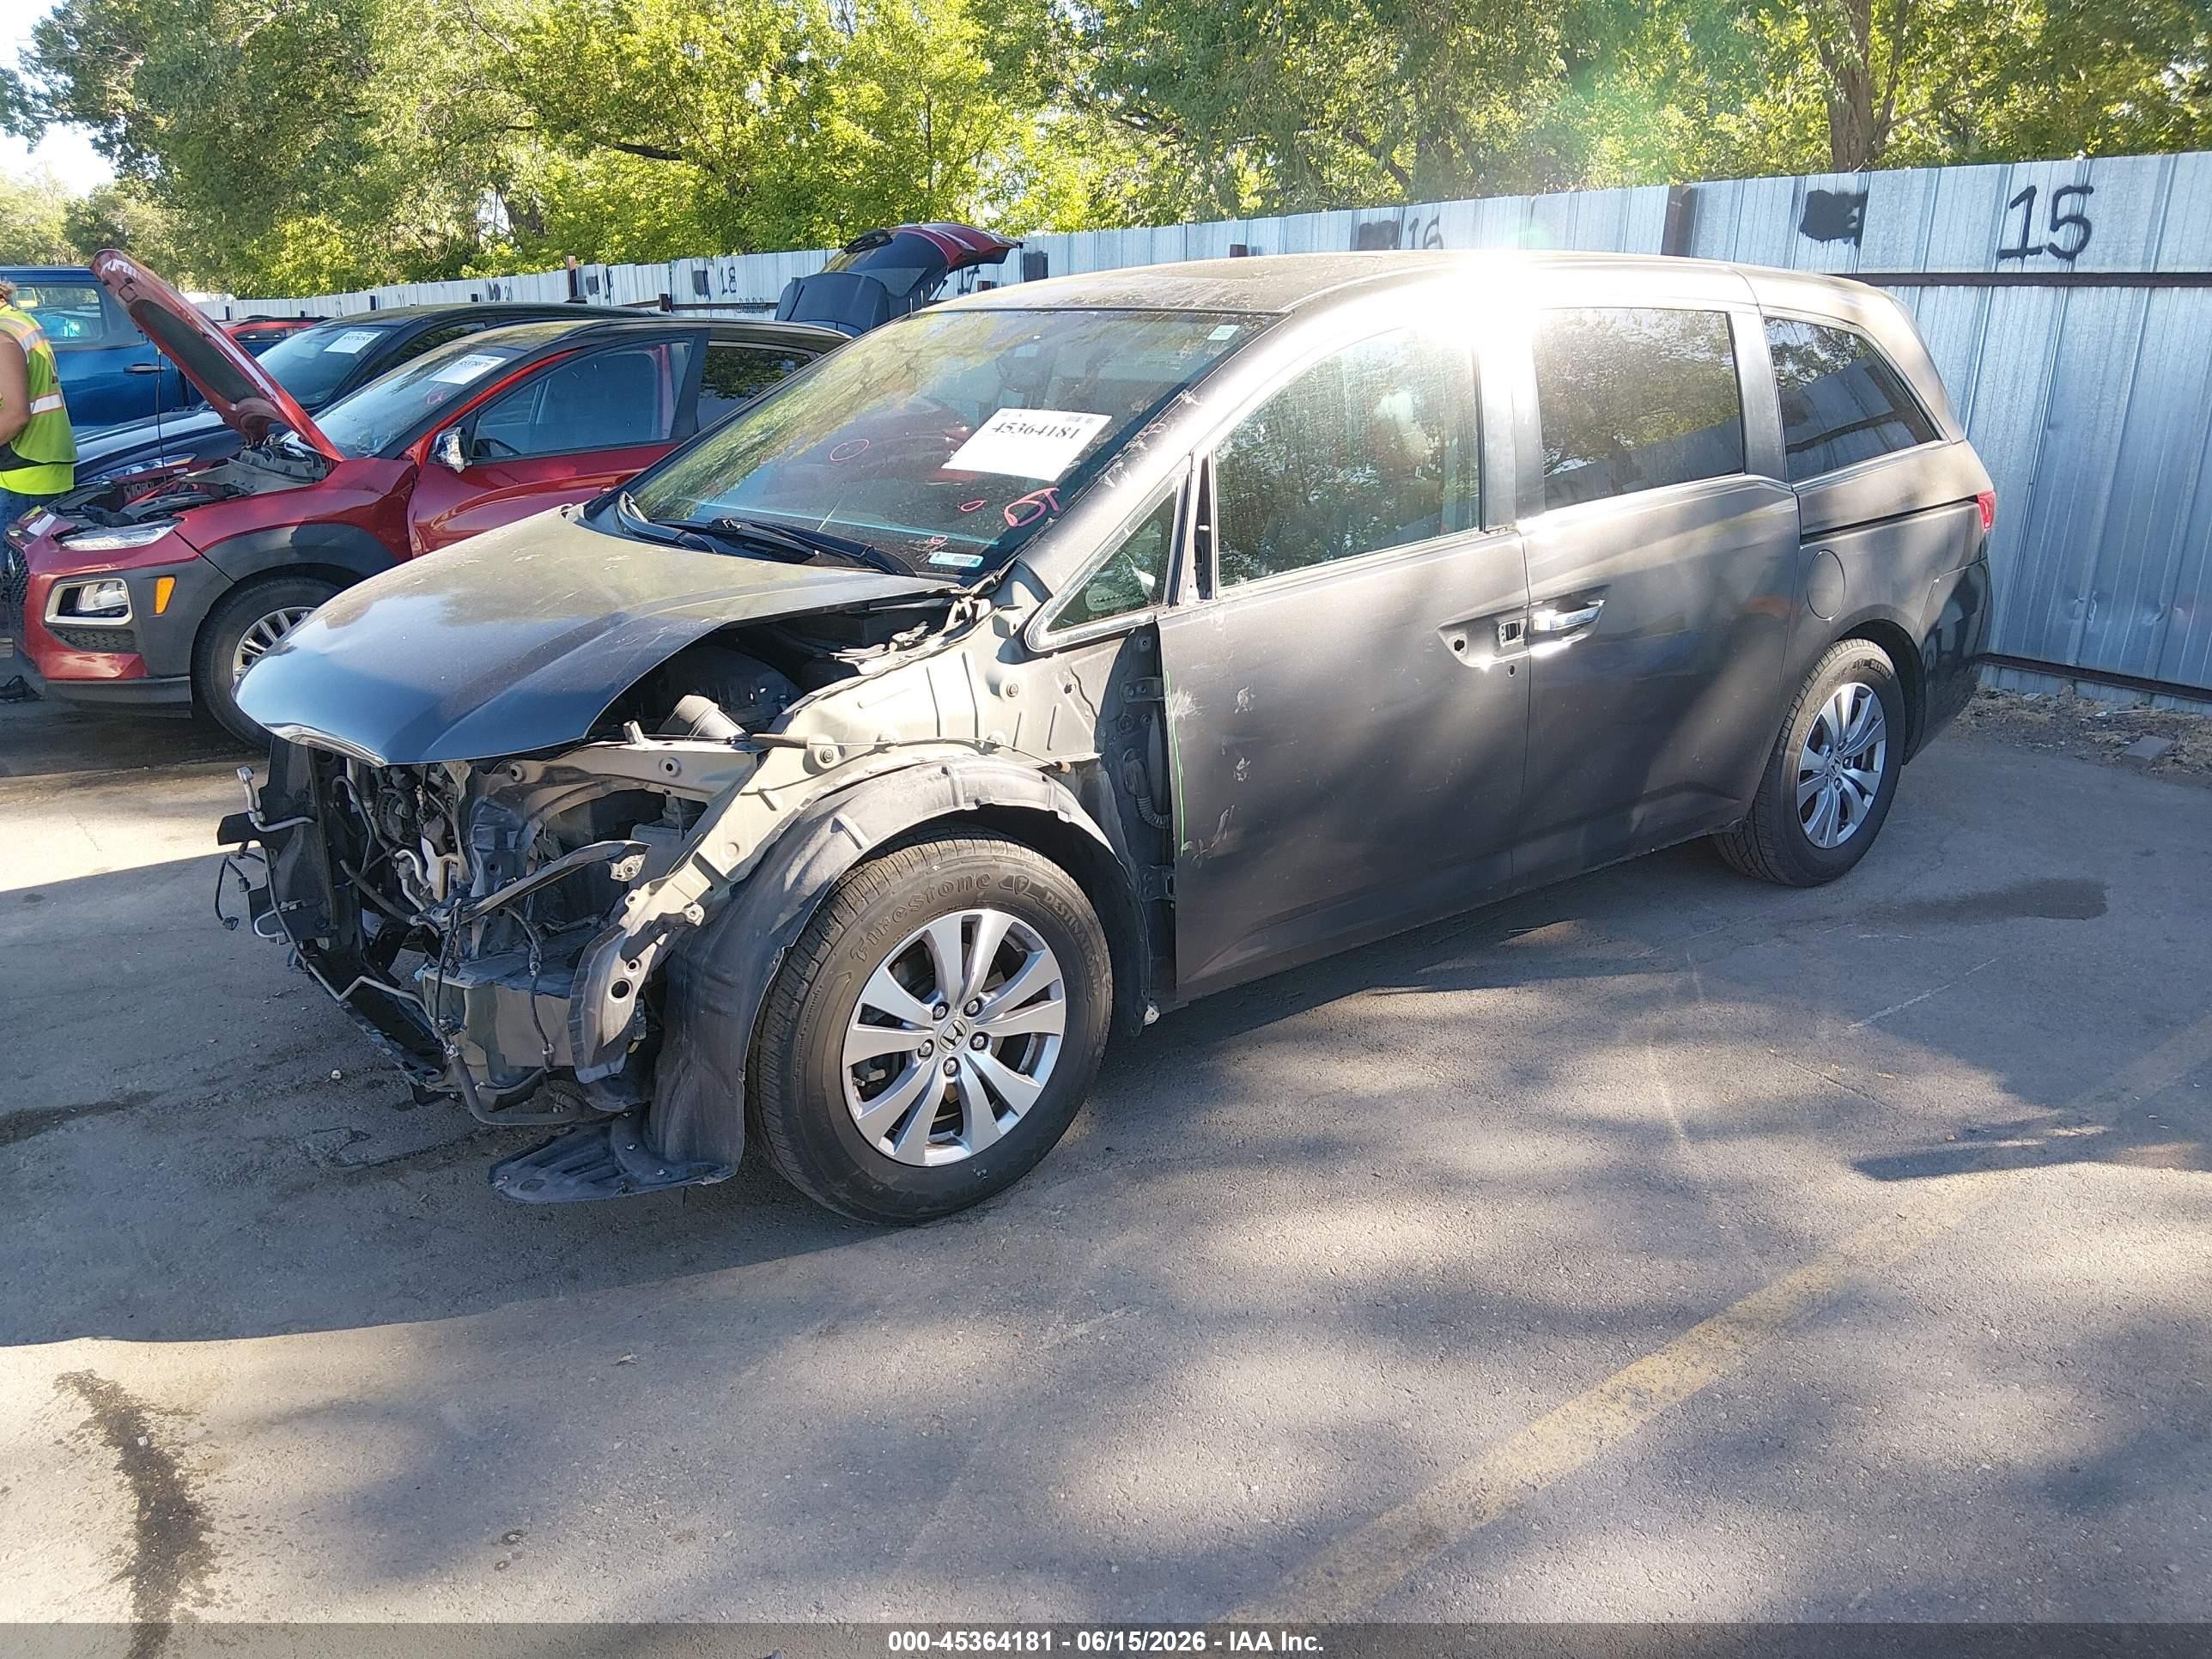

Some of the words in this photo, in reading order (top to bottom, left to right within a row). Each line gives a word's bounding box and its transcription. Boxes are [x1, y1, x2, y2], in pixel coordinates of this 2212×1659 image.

[1407, 215, 1444, 250] 16
[1996, 184, 2094, 263] 15
[720, 266, 738, 295] 18
[991, 422, 1081, 440] 45364181
[848, 872, 994, 963] Firestone
